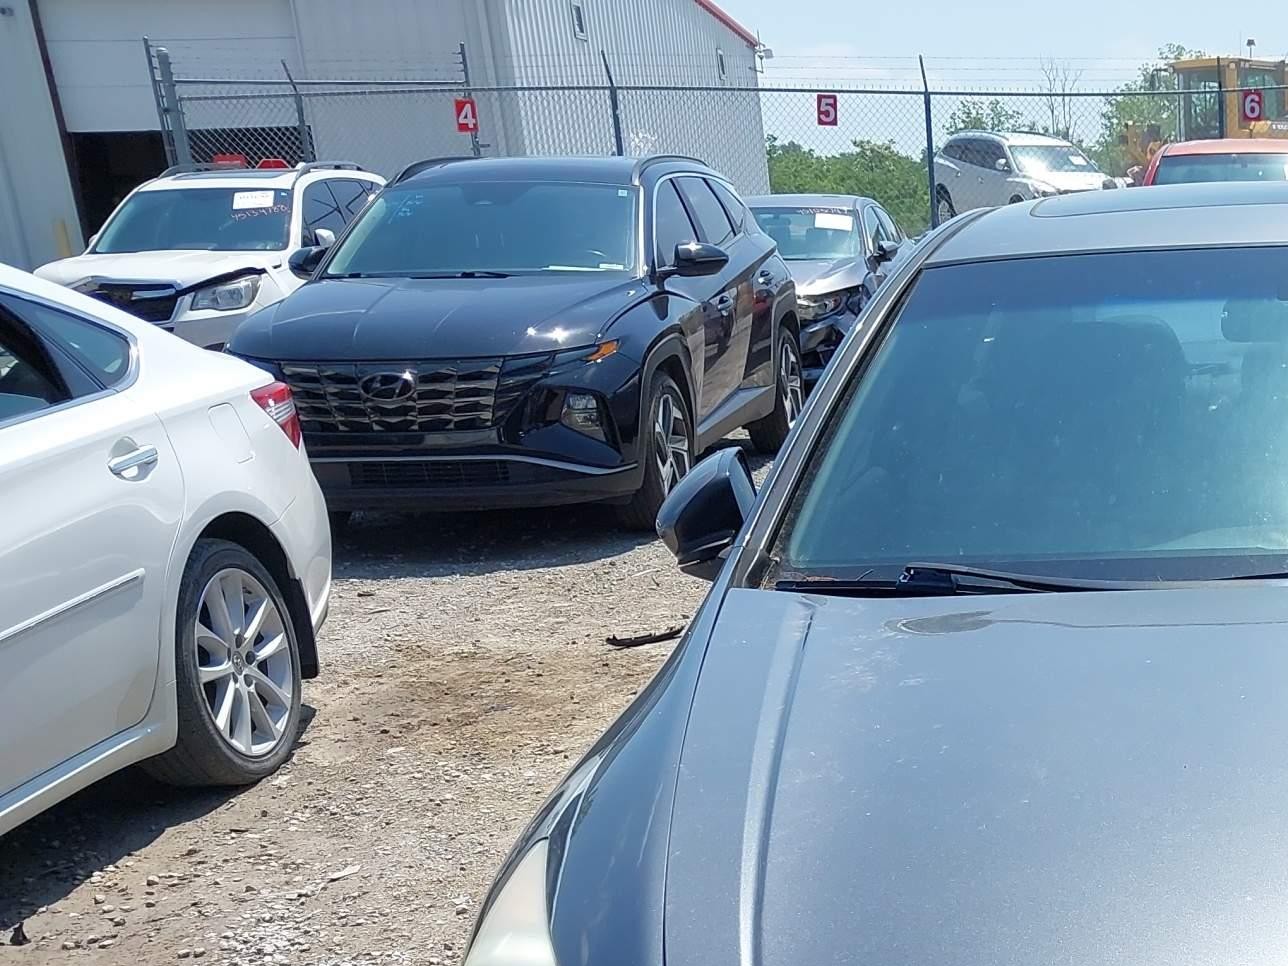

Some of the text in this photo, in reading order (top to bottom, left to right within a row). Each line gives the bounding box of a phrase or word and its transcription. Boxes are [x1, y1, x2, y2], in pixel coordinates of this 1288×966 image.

[458, 103, 476, 129] 4
[820, 98, 835, 122] 5
[1244, 94, 1260, 119] 6
